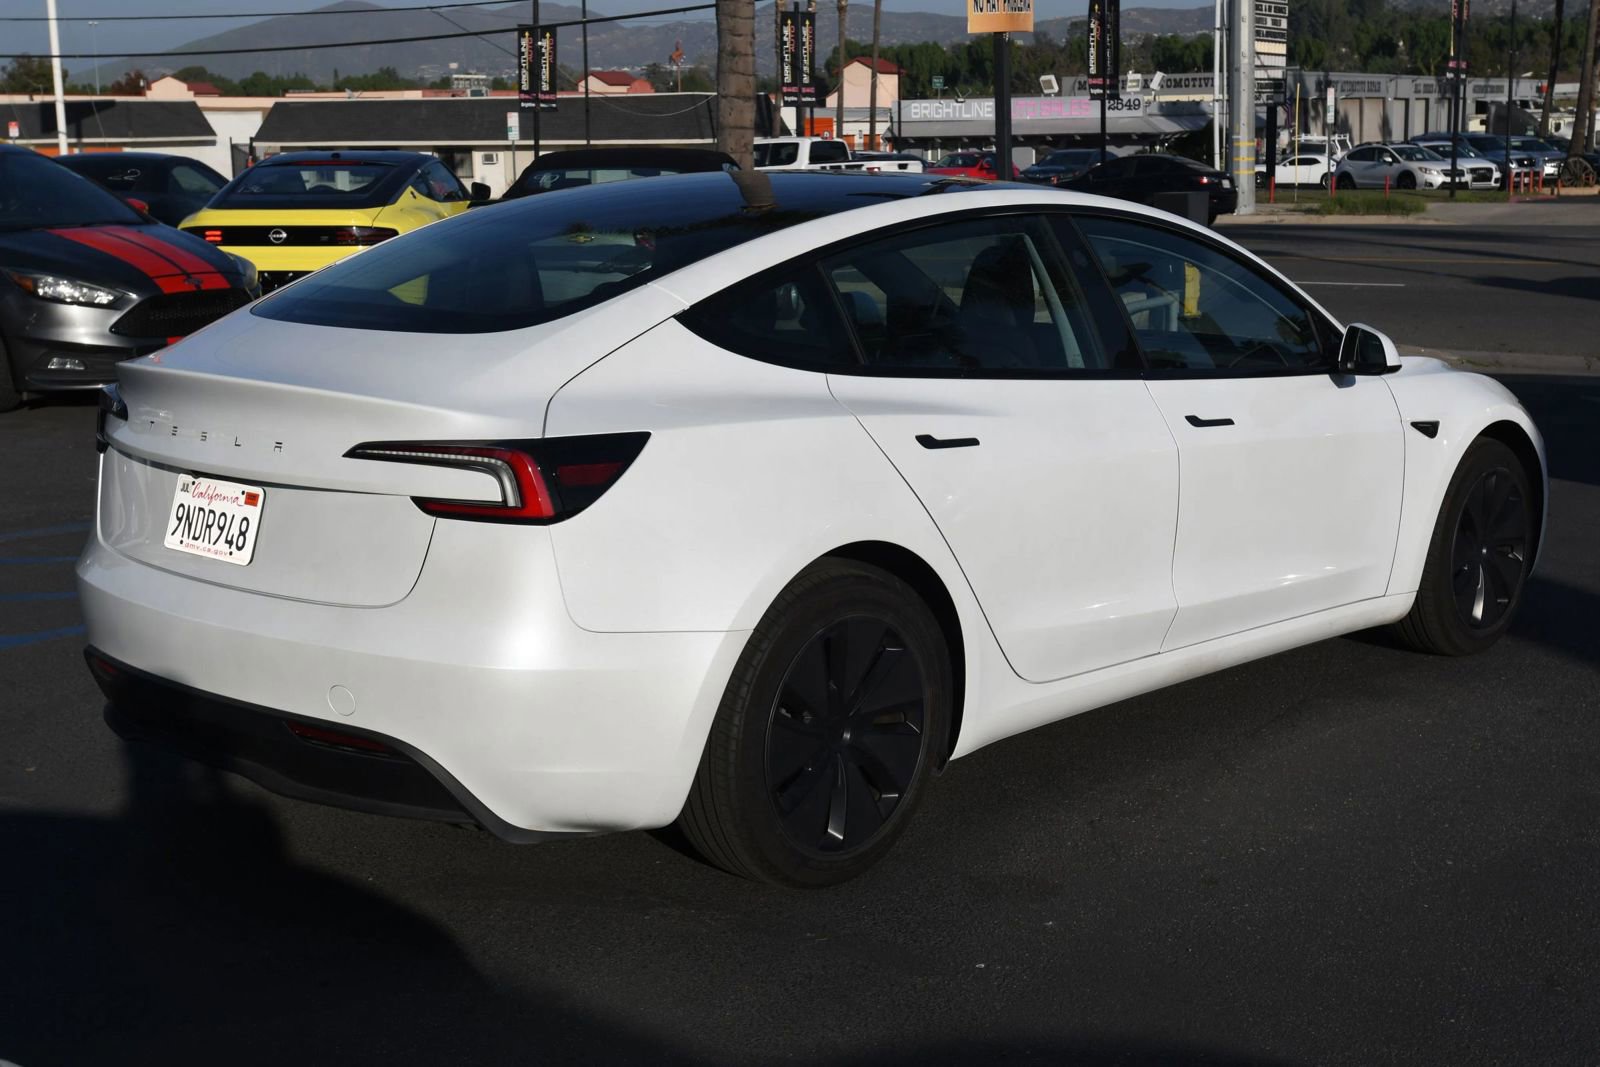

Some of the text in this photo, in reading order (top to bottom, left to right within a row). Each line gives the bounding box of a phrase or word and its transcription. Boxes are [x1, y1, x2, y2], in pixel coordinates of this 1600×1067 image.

[911, 101, 993, 118] BRIGHTLINE
[149, 420, 283, 453] TESLA
[191, 482, 244, 506] California
[171, 503, 250, 551] 9NDR948
[184, 542, 229, 556] dmv.ca.gov
